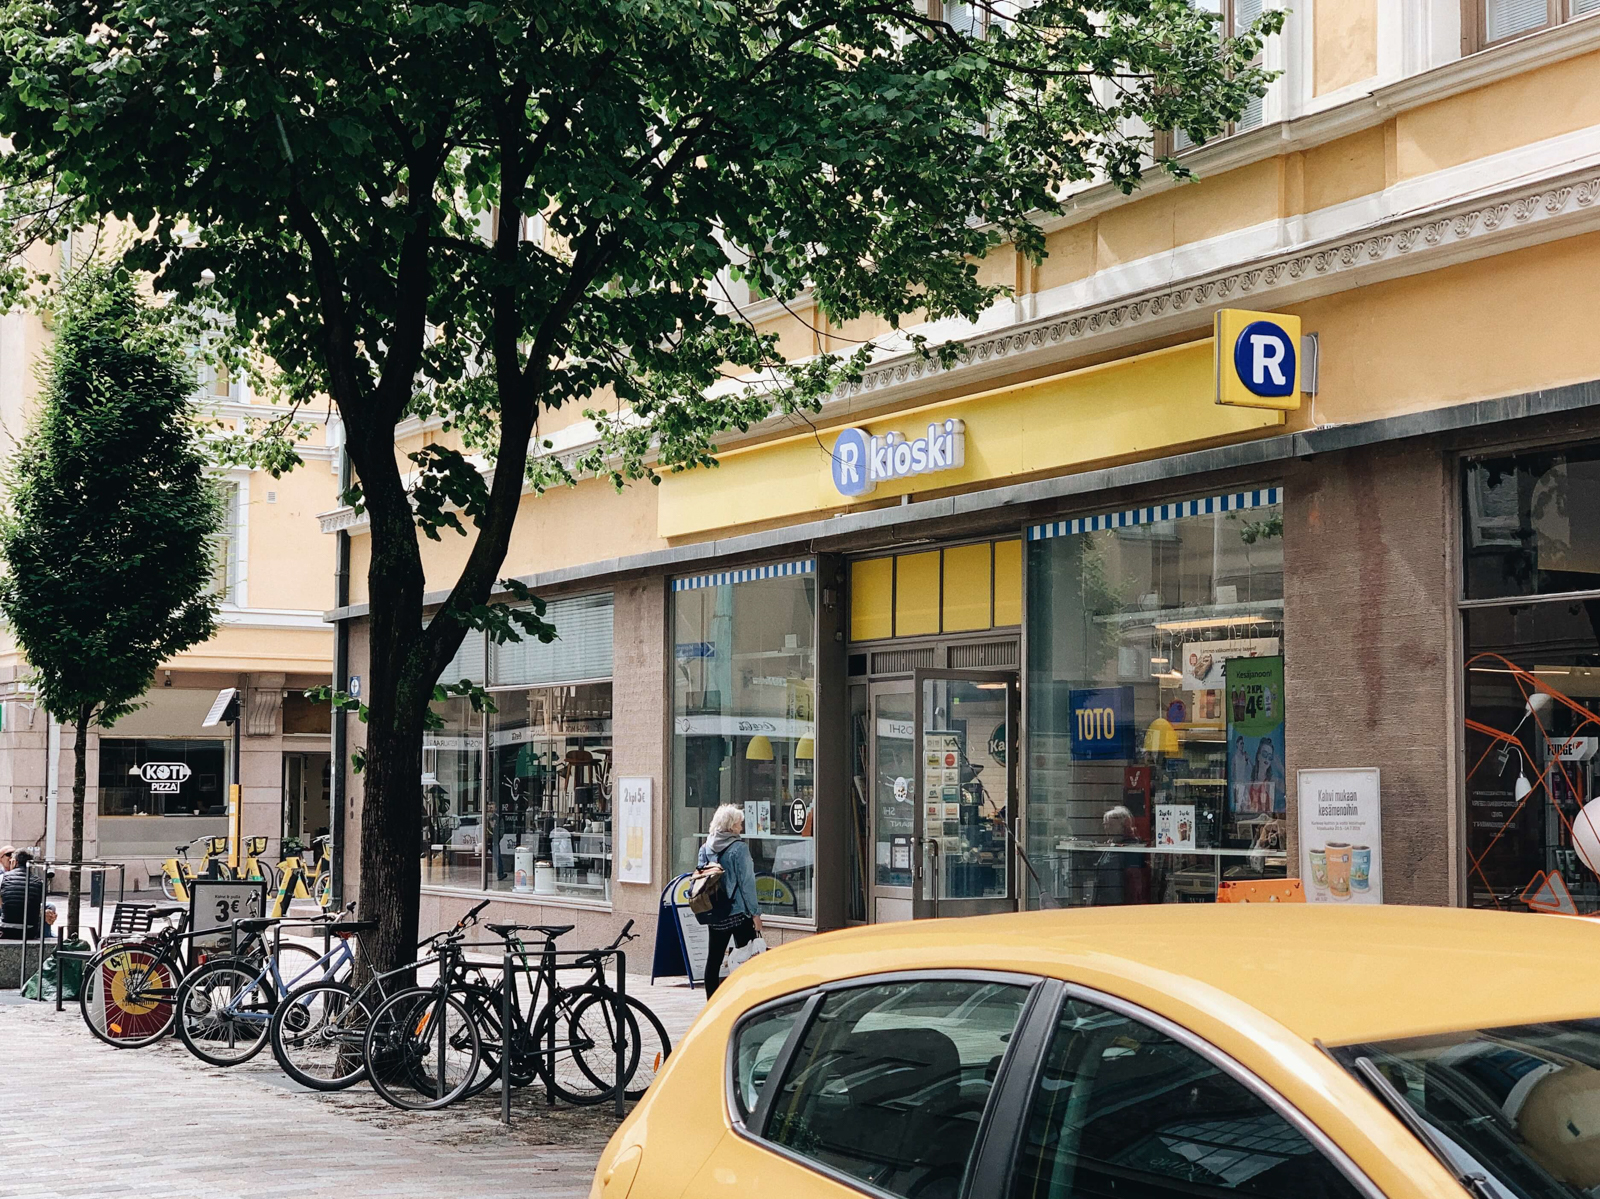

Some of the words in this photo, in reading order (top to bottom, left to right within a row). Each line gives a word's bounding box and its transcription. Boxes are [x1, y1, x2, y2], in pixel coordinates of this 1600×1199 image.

[1249, 334, 1287, 386] R
[839, 441, 860, 485] R
[870, 418, 954, 480] kioski
[1075, 708, 1115, 741] TOTO
[1547, 744, 1573, 756] FUDGE
[146, 765, 184, 780] KOTI
[151, 783, 177, 791] PIZZA
[623, 787, 629, 803] 2
[1317, 789, 1334, 802] Kahvi
[1334, 789, 1358, 802] mukaan
[1318, 803, 1359, 816] kesämenoihin
[215, 900, 240, 923] 3€
